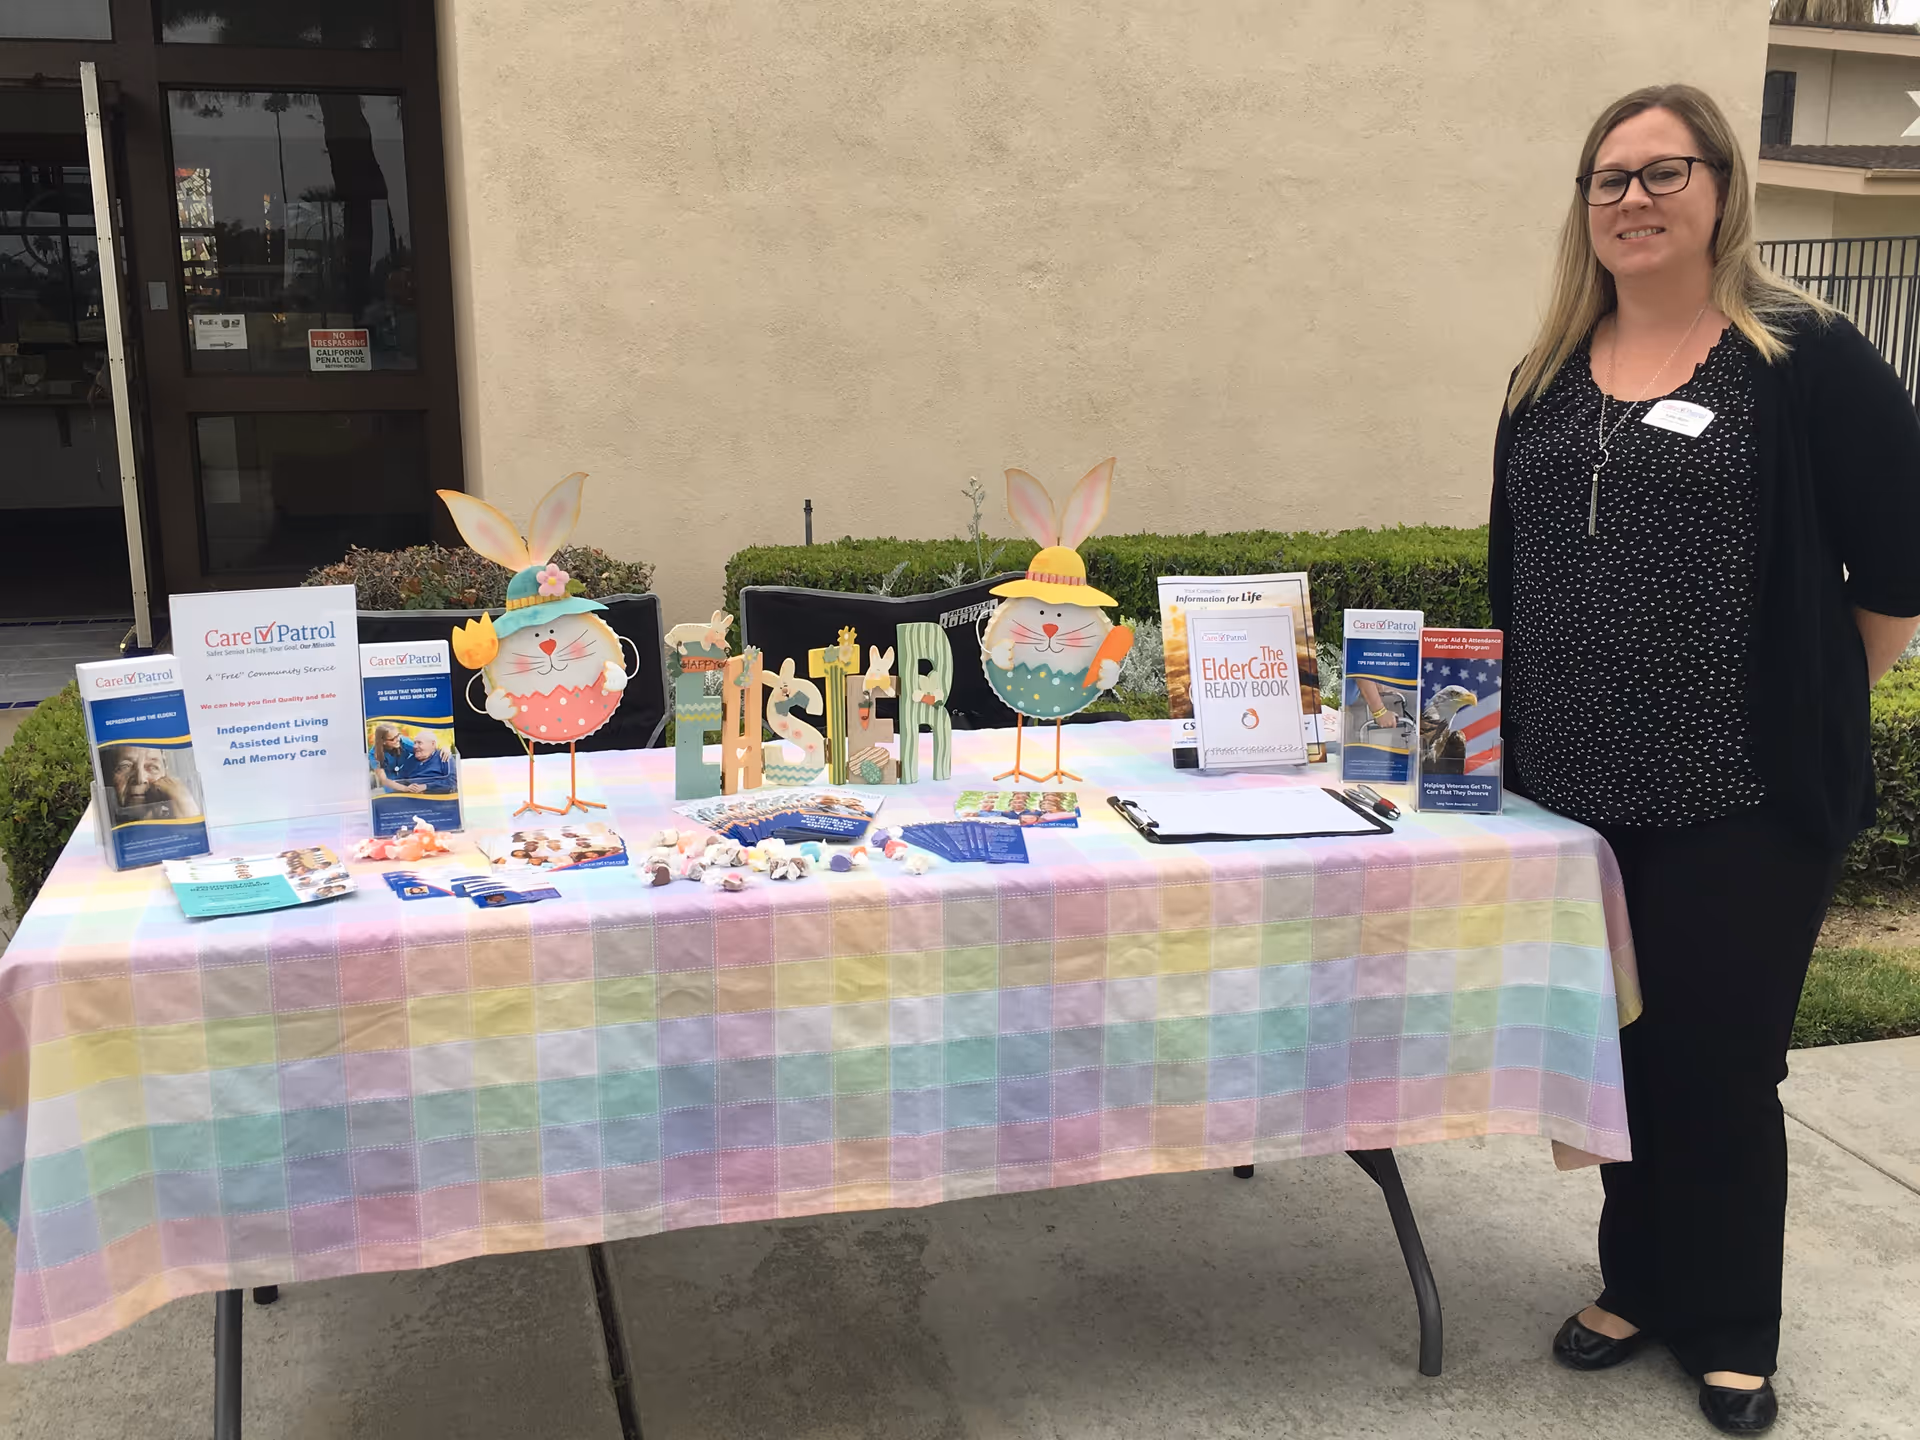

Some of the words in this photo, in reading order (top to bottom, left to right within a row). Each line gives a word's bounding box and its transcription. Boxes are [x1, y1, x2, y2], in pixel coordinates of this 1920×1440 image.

[332, 332, 346, 340] NO
[1176, 595, 1225, 604] Information
[1226, 595, 1239, 604] for
[1241, 591, 1262, 604] Life
[948, 600, 989, 616] FREESTYLE
[1353, 620, 1376, 629] Care
[1387, 620, 1416, 630] Patrol
[204, 629, 252, 648] Care
[277, 621, 336, 642] Patrol
[224, 648, 244, 656] Senior
[246, 646, 268, 654] Living,
[1260, 646, 1284, 661] The
[369, 657, 395, 666] Care
[408, 653, 441, 664] Patrol
[681, 659, 718, 670] HAPPY
[216, 671, 244, 681] "Free"
[248, 668, 301, 678] Community
[304, 665, 336, 674] Service
[1202, 657, 1288, 681] ElderCare
[95, 677, 123, 688] Care
[137, 668, 173, 683] Patrol
[1204, 681, 1248, 698] READY
[1252, 680, 1290, 697] BOOK
[675, 622, 954, 800] EASTER
[105, 717, 135, 726] DEPRESSION
[217, 720, 290, 735] Independent
[294, 717, 329, 727] Living
[230, 737, 280, 749] Assisted
[284, 734, 318, 743] Living
[223, 756, 246, 766] And
[250, 751, 296, 763] Memory
[300, 748, 327, 758] Care
[807, 823, 844, 831] Options
